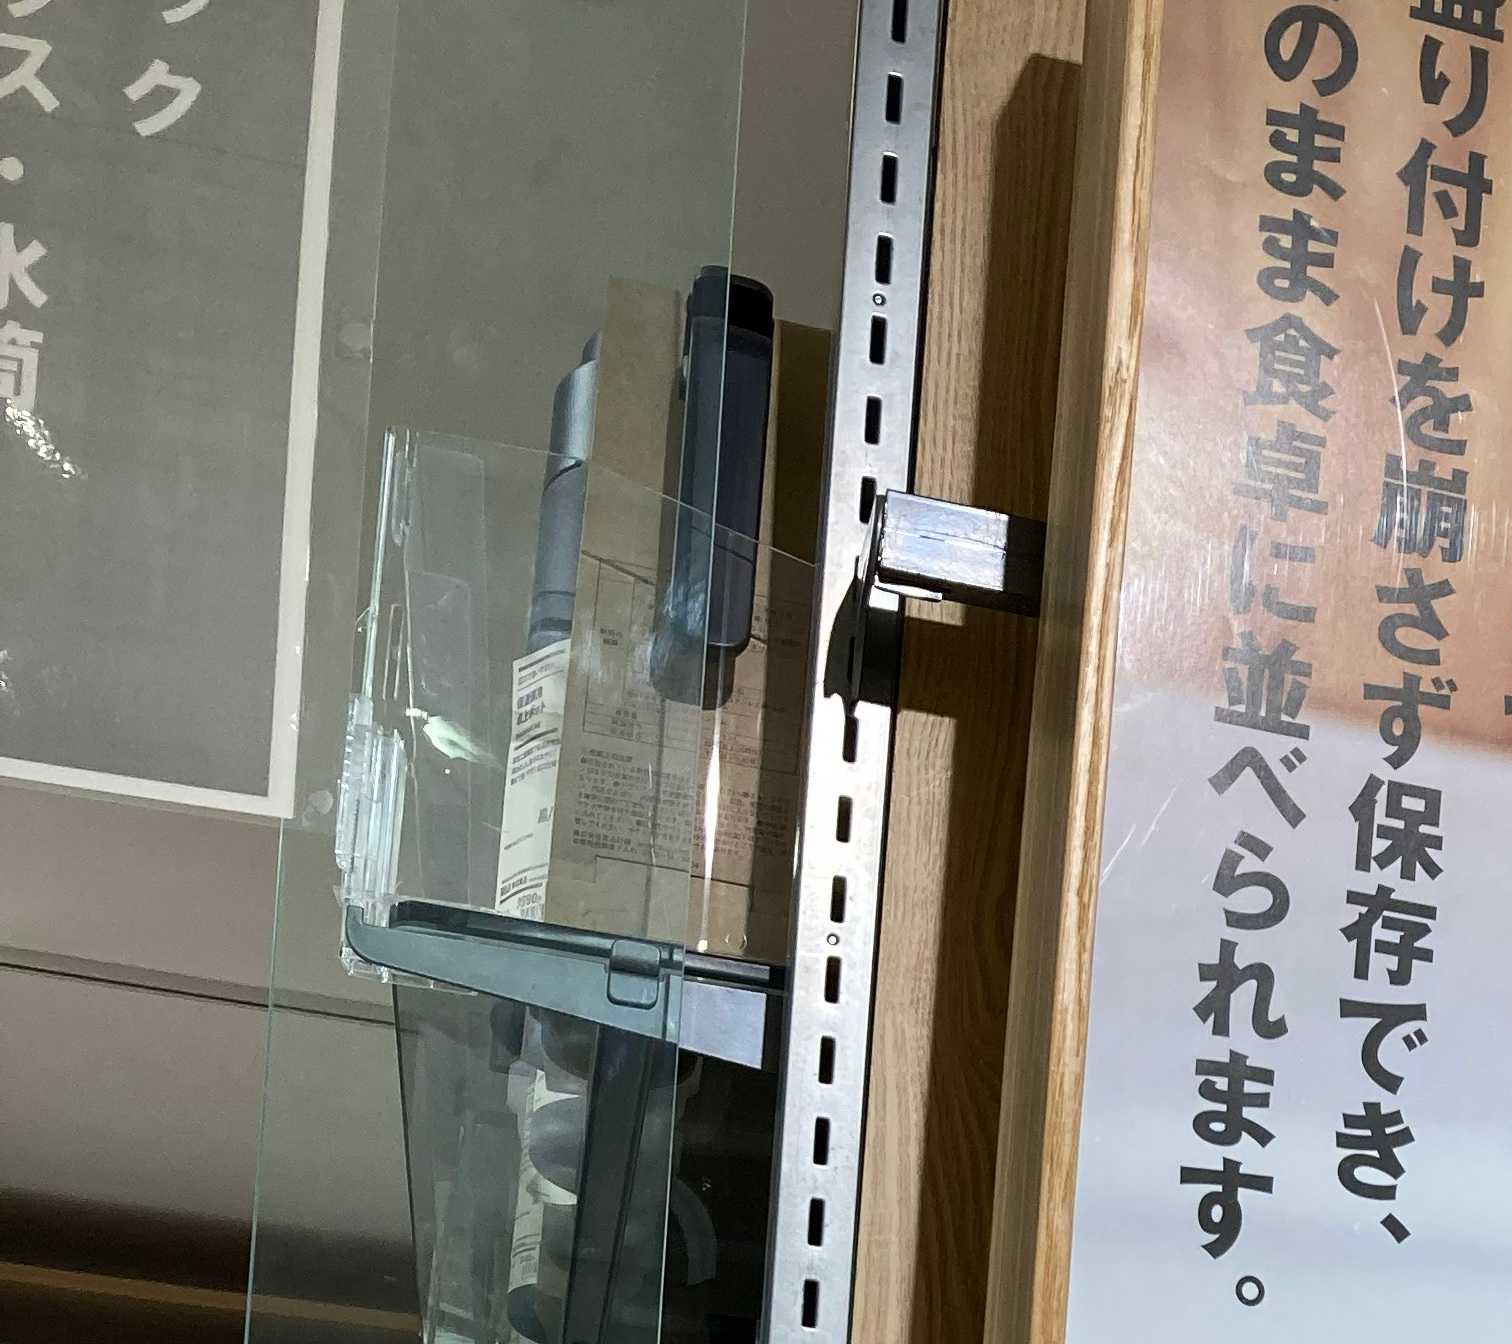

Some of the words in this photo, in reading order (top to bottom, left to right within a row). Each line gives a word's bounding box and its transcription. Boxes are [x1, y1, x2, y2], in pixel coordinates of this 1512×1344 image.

[1180, 0, 1358, 1306] のまま食卓に並べられます。
